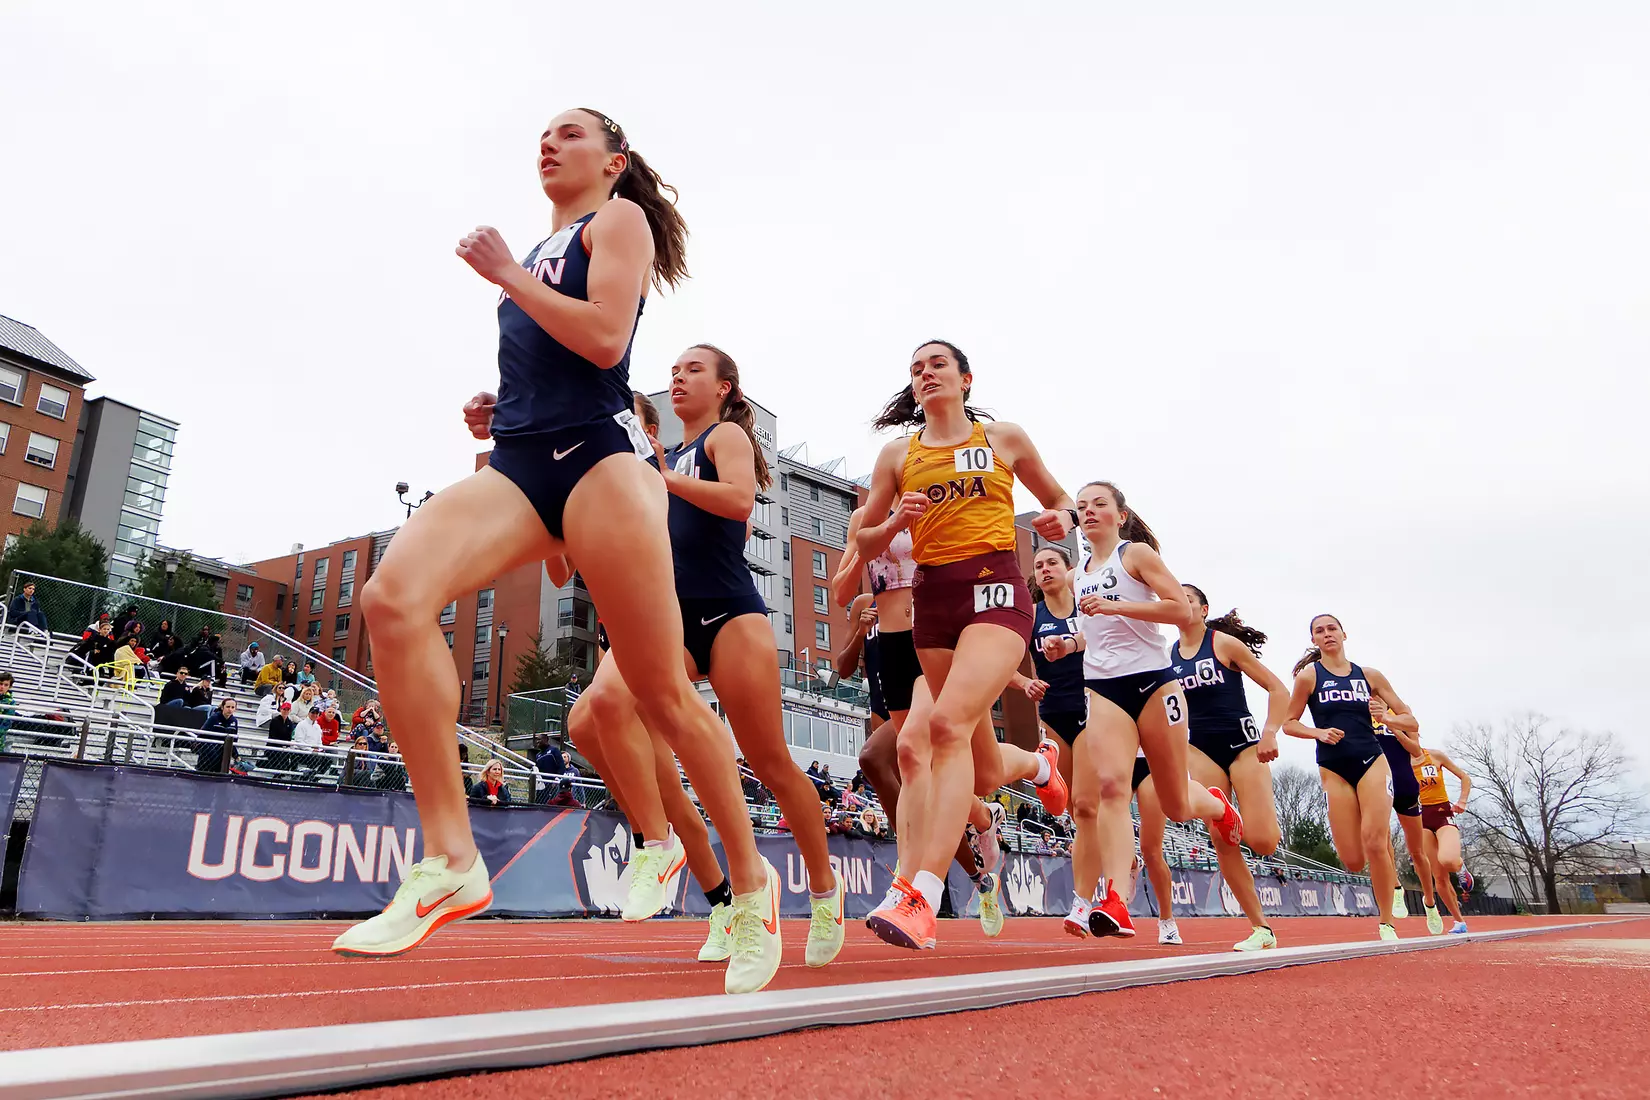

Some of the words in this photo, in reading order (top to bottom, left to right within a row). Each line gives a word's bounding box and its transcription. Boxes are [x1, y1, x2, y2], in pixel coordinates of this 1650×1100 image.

[961, 448, 988, 470] 10
[924, 476, 987, 504] ONA
[1101, 566, 1118, 590] 3
[981, 584, 1008, 608] 10
[1080, 583, 1100, 597] NEW
[1198, 660, 1214, 681] 6
[1355, 680, 1368, 697] 4
[1166, 695, 1181, 722] 3
[1243, 718, 1258, 740] 6
[1424, 766, 1437, 776] 12
[1420, 777, 1438, 788] NA
[186, 812, 417, 883] UCONN
